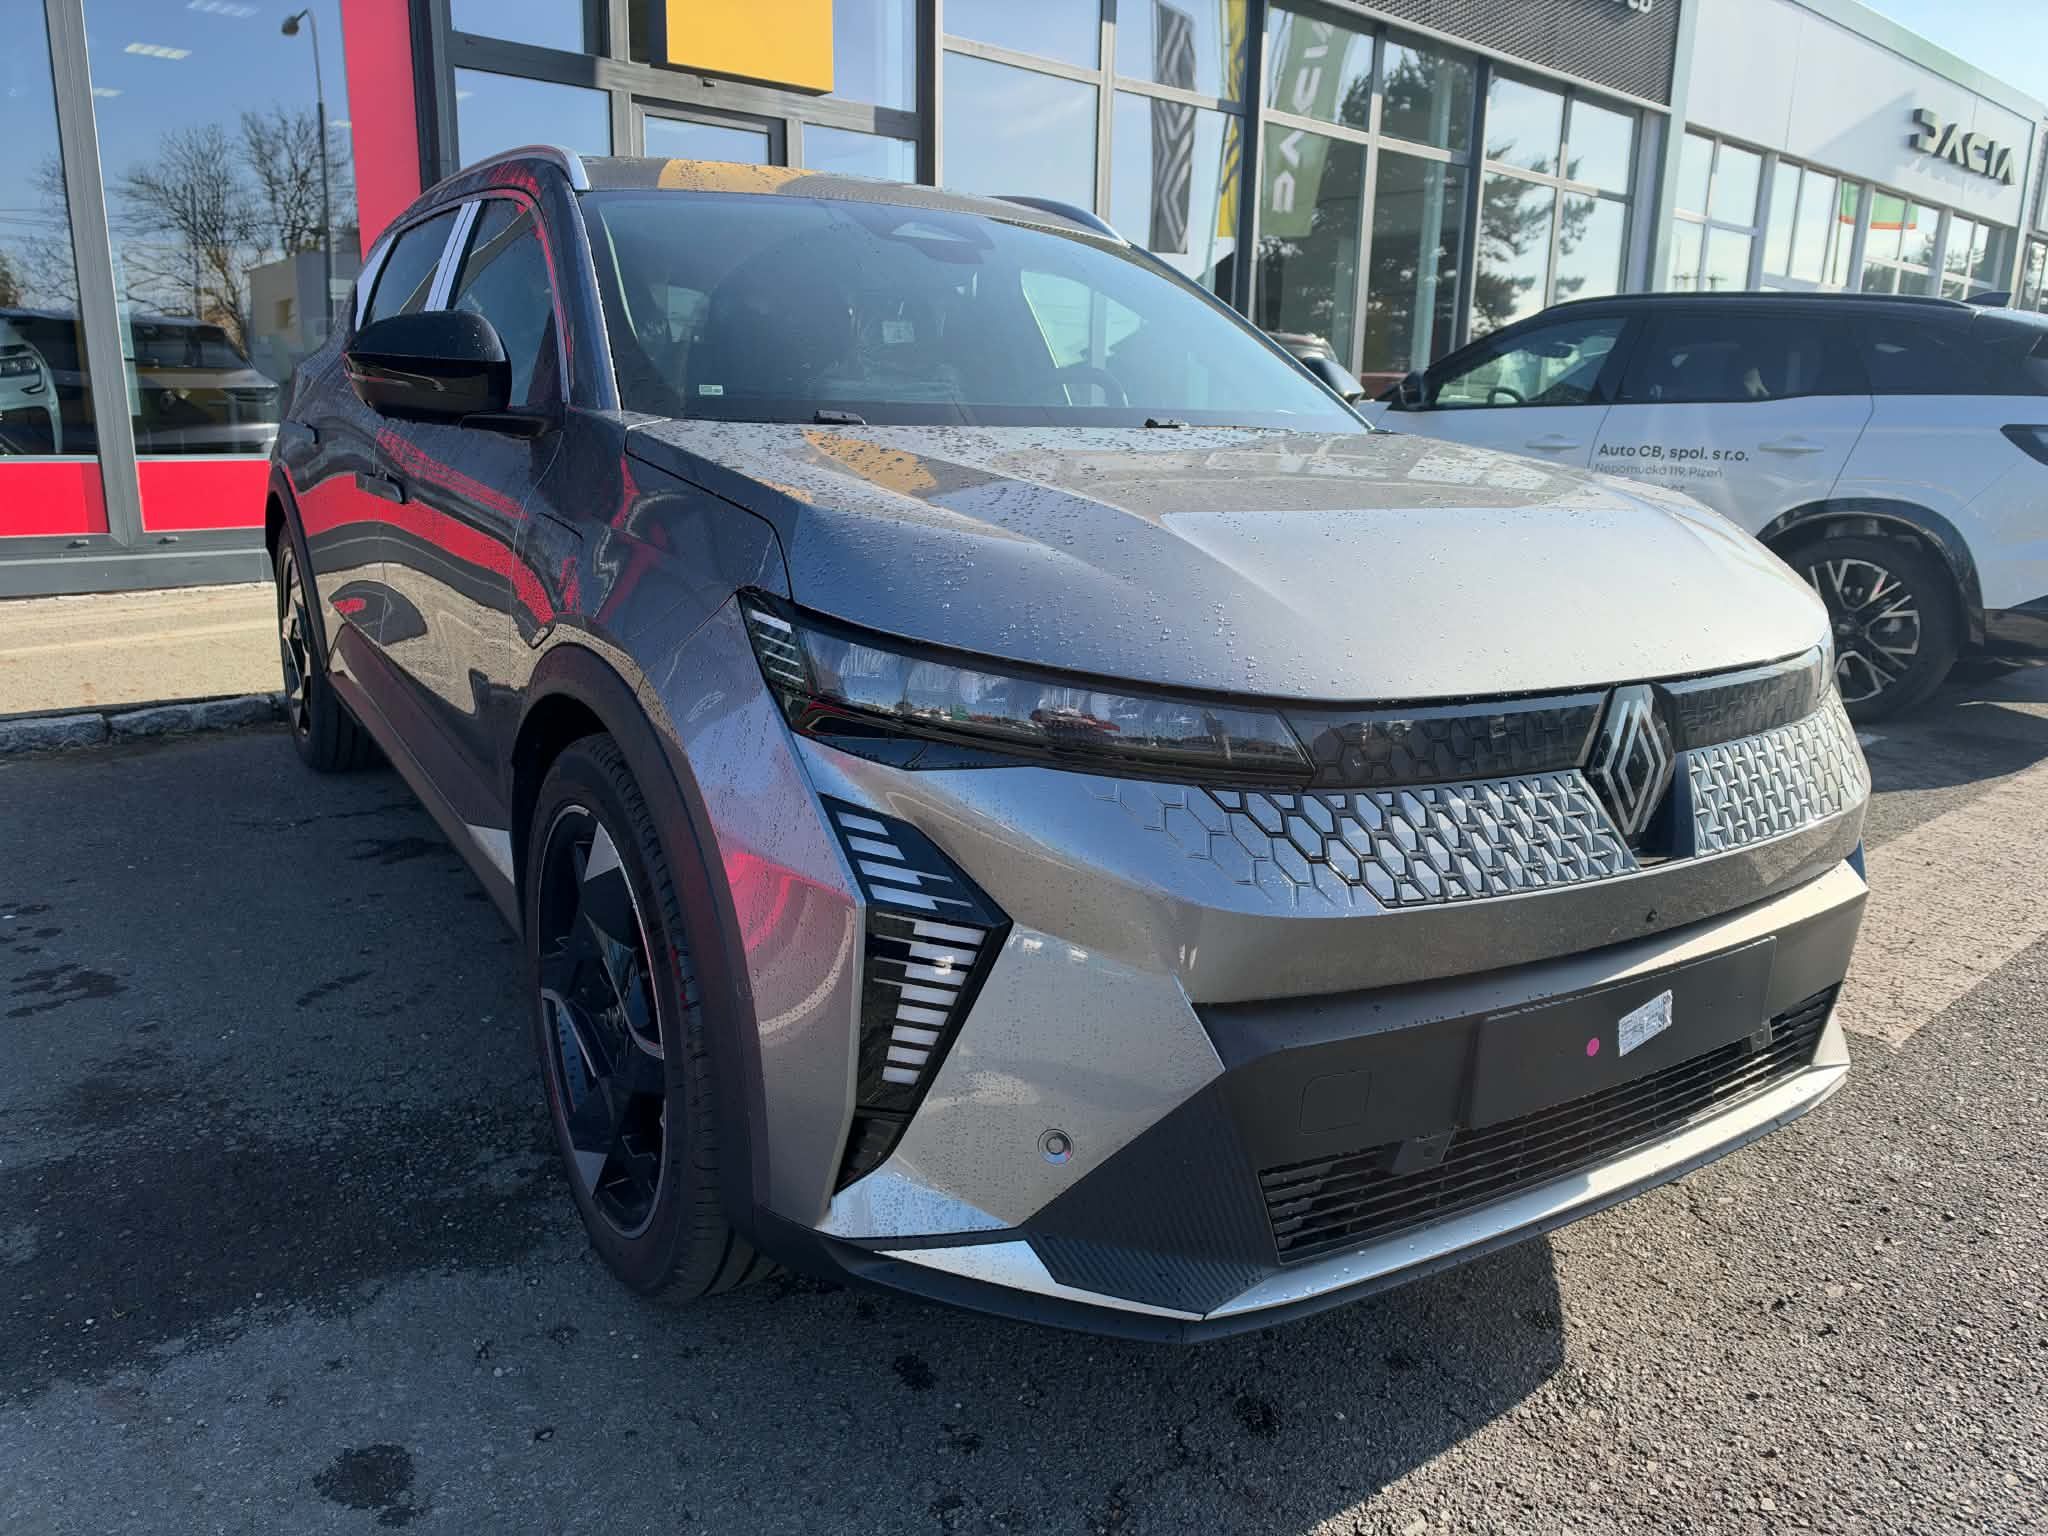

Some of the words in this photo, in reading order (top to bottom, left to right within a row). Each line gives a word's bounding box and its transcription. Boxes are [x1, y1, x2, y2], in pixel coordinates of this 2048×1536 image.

[1909, 108, 2017, 186] DACIA
[1598, 443, 1636, 457] Auto
[1639, 444, 1665, 460] CB,
[1669, 446, 1708, 461] spol.
[1712, 449, 1721, 460] s
[1724, 450, 1749, 462] r.o.
